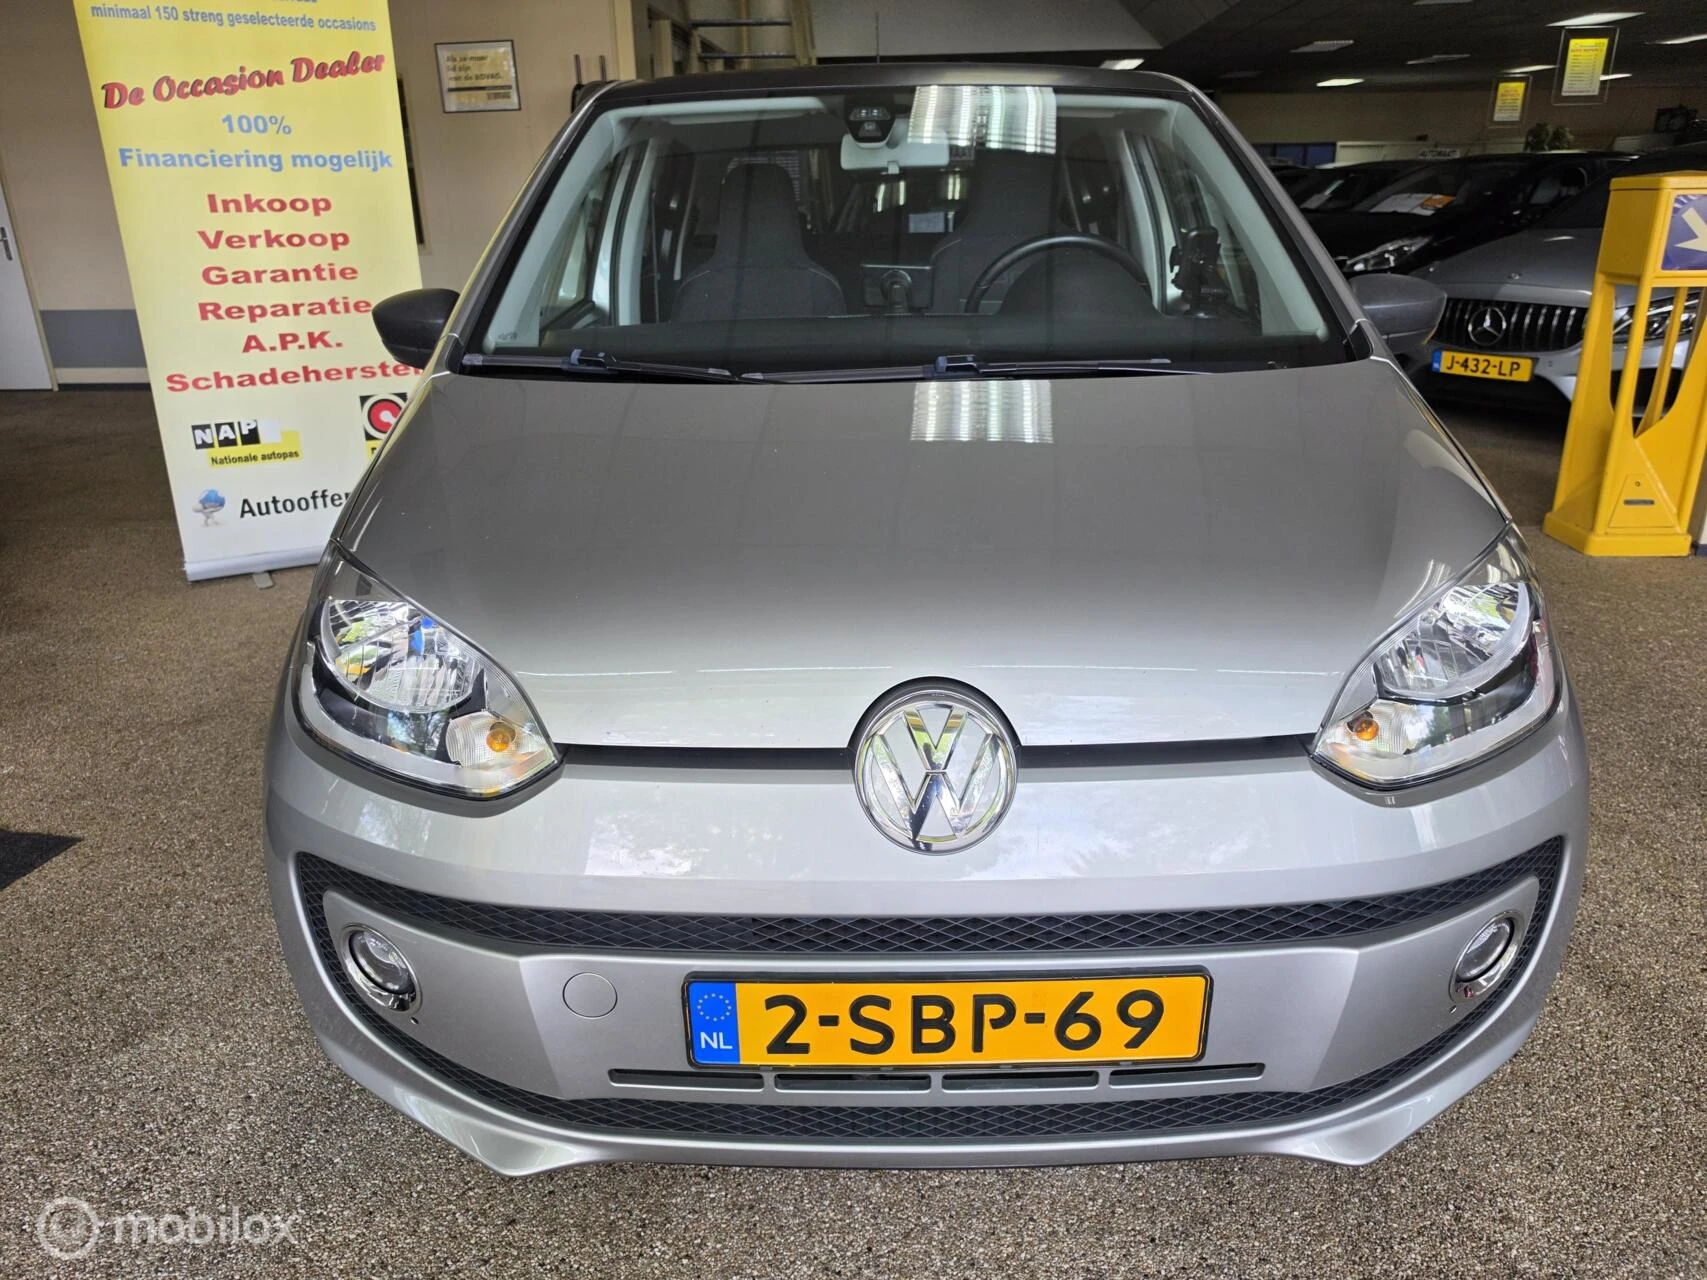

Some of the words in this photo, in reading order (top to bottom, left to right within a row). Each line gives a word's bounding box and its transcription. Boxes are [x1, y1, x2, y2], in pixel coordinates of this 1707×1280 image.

[91, 4, 151, 19] minimaal
[155, 6, 179, 20] 150
[183, 8, 224, 27] streng
[227, 11, 315, 29] geselecteerde
[318, 17, 377, 31] occasions
[102, 82, 145, 109] De
[153, 66, 285, 102] Occasion
[290, 51, 386, 83] Dealer
[222, 114, 292, 135] 100%
[118, 148, 283, 172] Financiering
[291, 150, 393, 172] mogelijk
[207, 193, 332, 216] Inkoop
[197, 229, 350, 251] Verkoop
[201, 263, 359, 285] Garantie
[197, 296, 372, 323] Reparatie
[242, 330, 344, 353] A.P.K.
[1446, 355, 1521, 377] J-432-LP
[193, 419, 258, 446] NAP
[211, 454, 258, 466] Nationale
[261, 450, 300, 462] autopas
[700, 1032, 733, 1051] NL
[764, 988, 1166, 1055] 2-SBP-69
